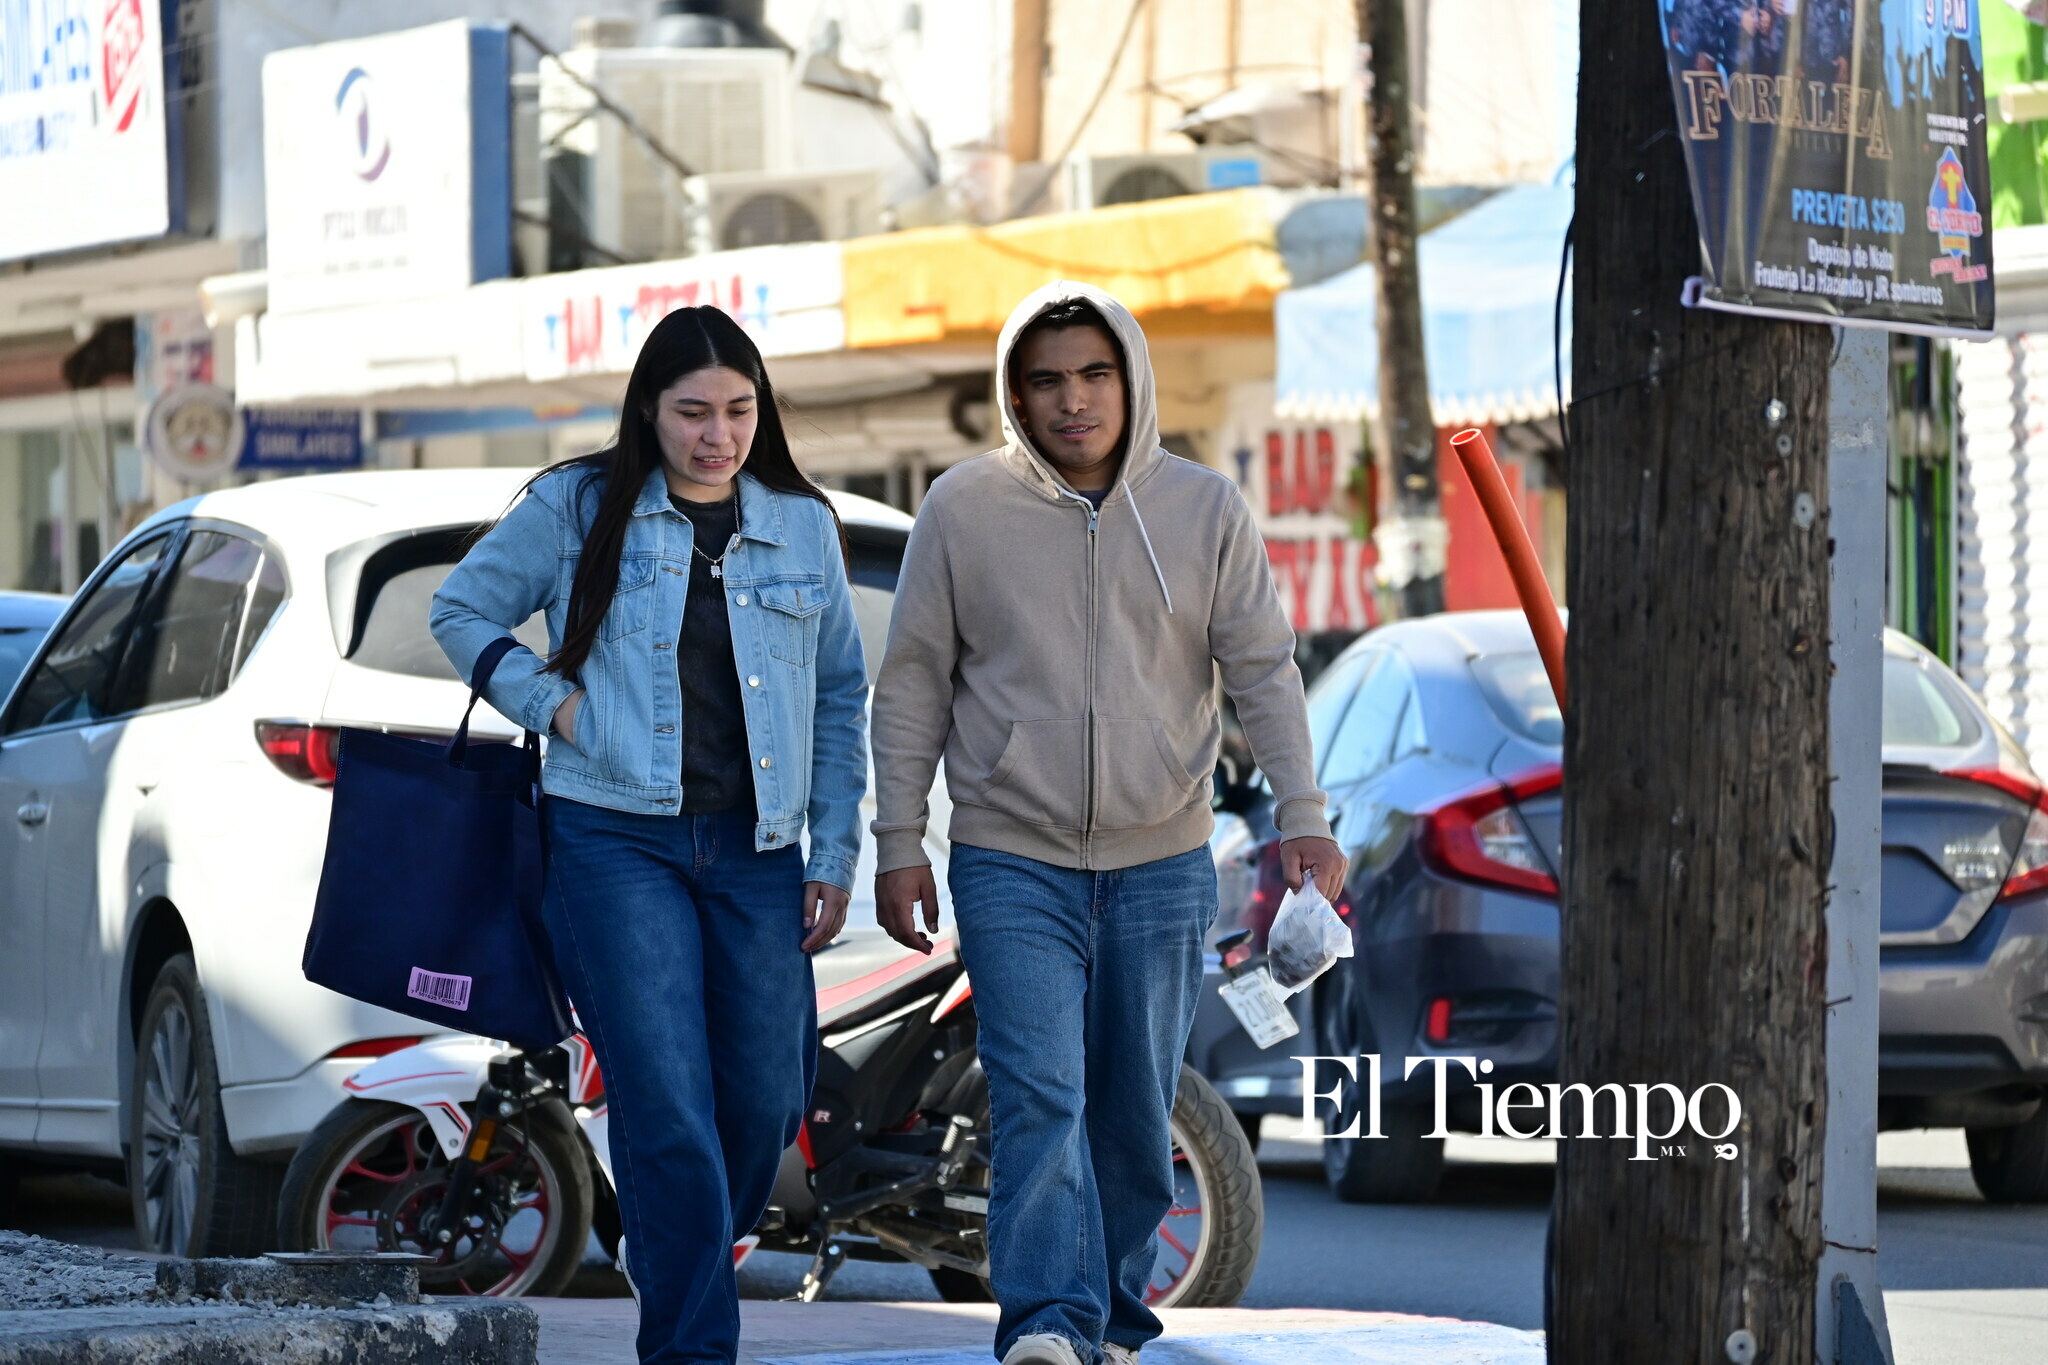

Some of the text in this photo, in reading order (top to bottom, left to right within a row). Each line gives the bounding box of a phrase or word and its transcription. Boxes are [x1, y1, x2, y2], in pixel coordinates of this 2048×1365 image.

[1925, 0, 1968, 33] 9 PM
[1791, 188, 1870, 231] PREVETA
